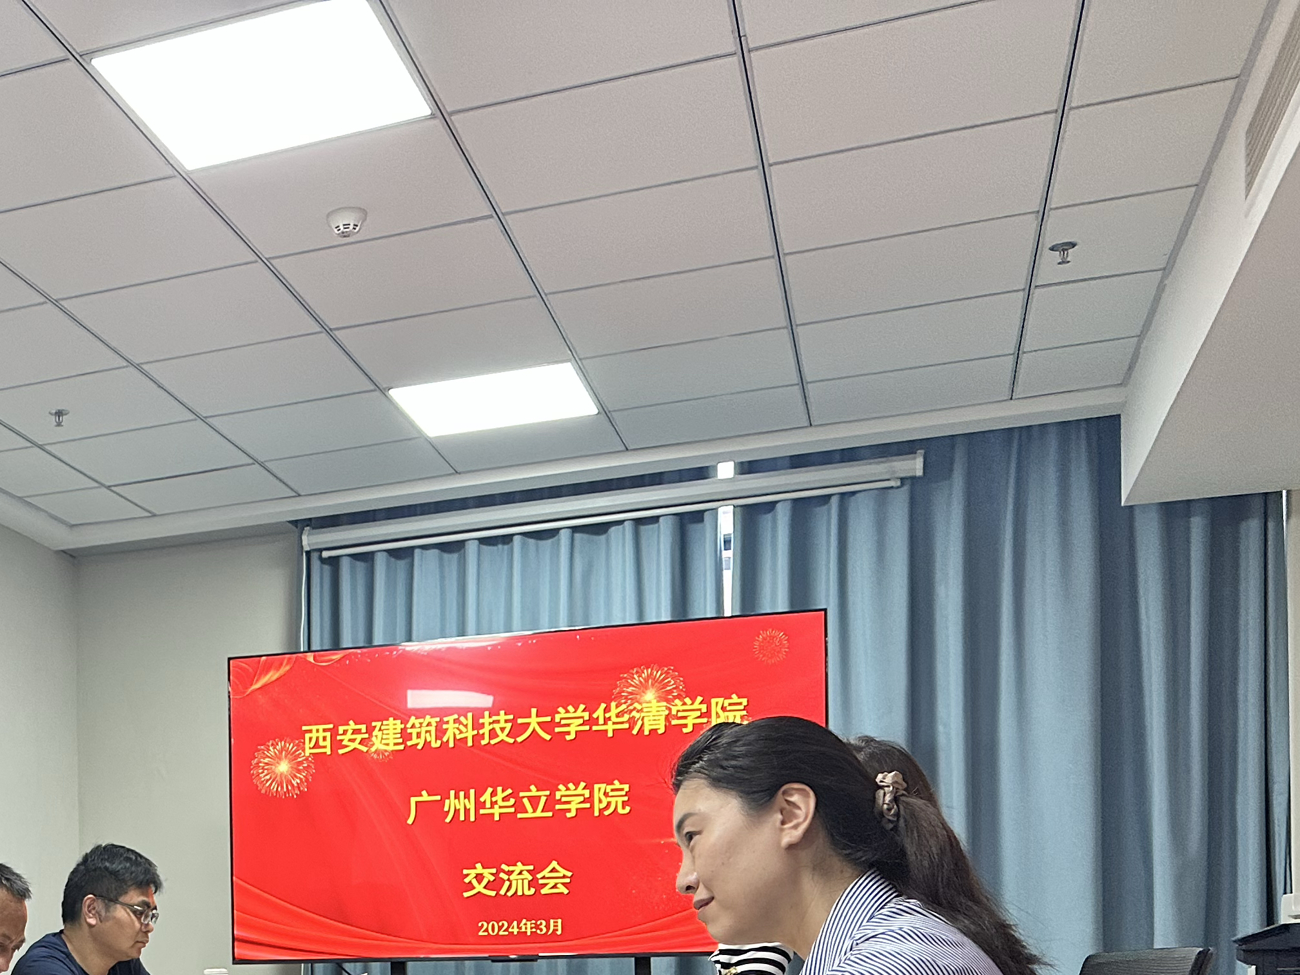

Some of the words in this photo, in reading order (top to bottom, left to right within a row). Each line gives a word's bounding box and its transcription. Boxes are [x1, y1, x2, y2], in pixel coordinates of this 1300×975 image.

[301, 693, 749, 757] 西安建筑科技大学华清学院
[406, 779, 632, 826] 广州华立学院
[462, 860, 573, 898] 交流会
[478, 918, 563, 936] 2024年3月
